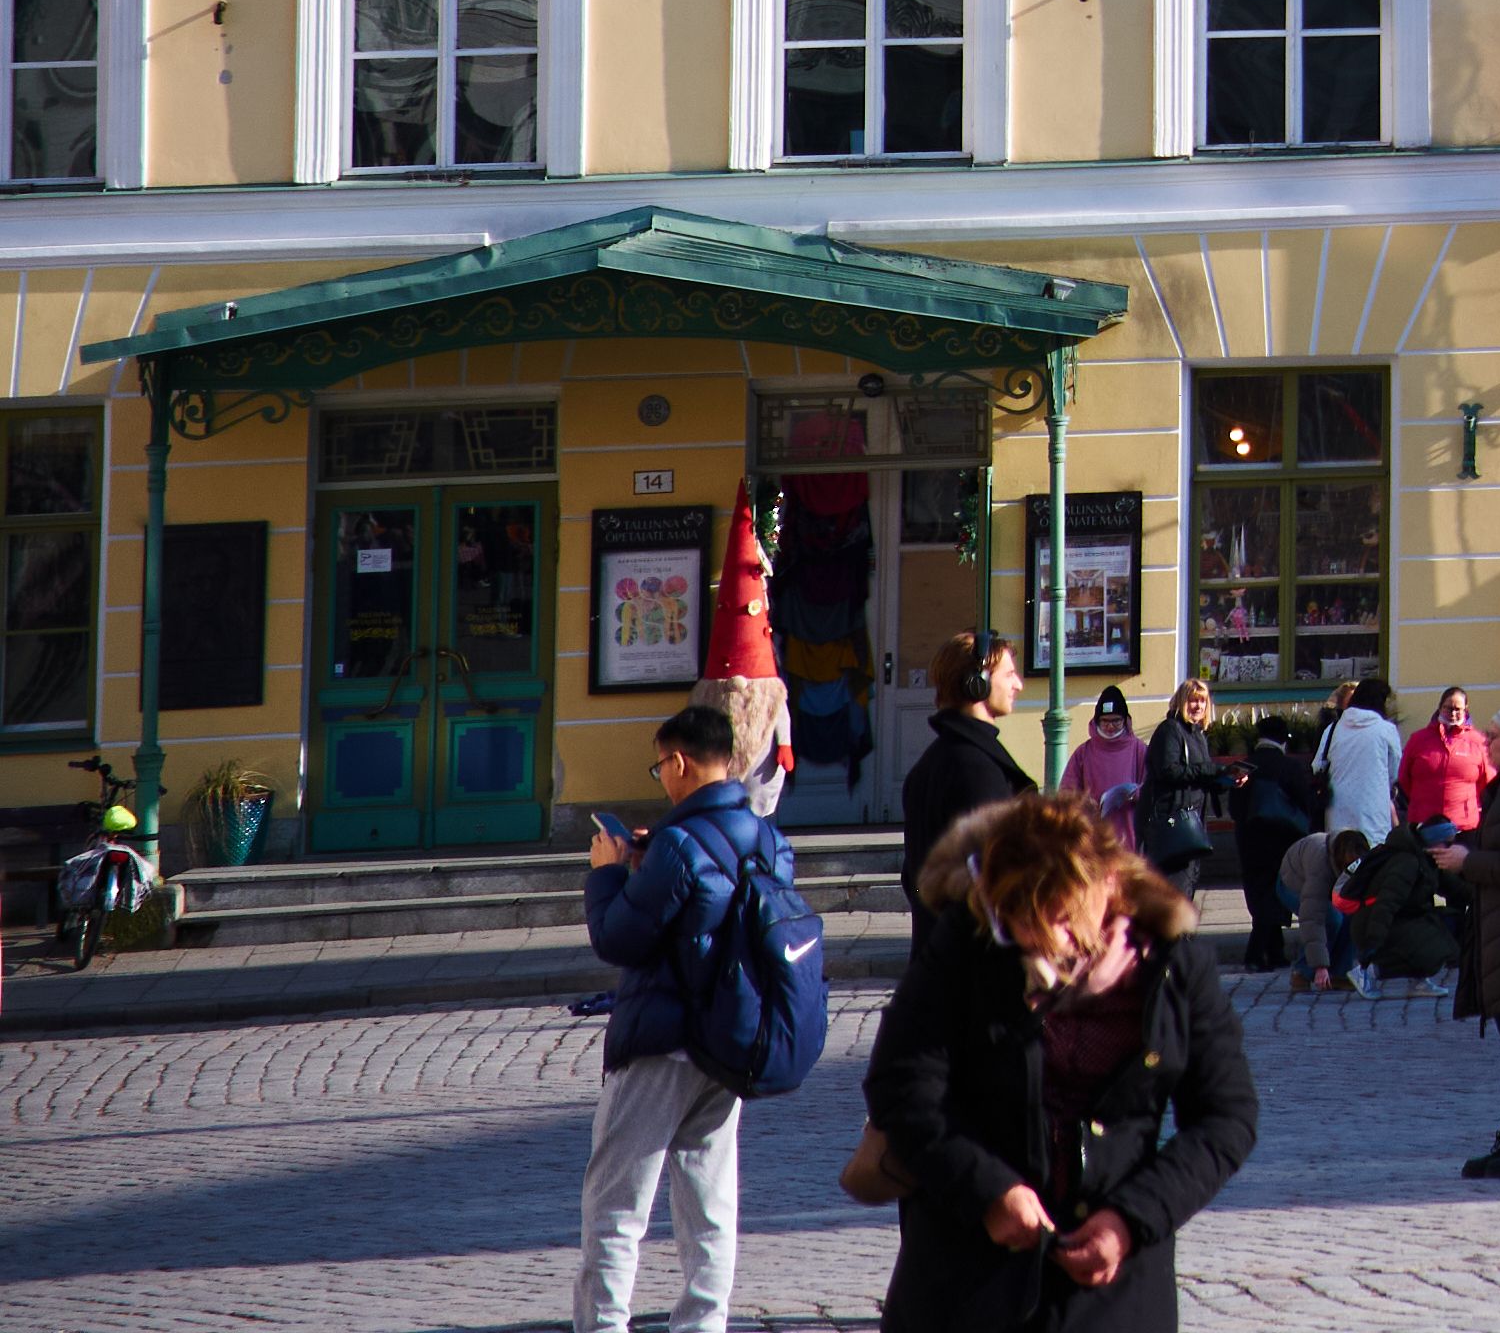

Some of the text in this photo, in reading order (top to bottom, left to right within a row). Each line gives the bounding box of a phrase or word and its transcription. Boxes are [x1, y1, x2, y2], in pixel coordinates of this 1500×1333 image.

[643, 474, 663, 490] 14
[1064, 503, 1112, 514] ALLINNA
[624, 517, 680, 531] TALLINNA
